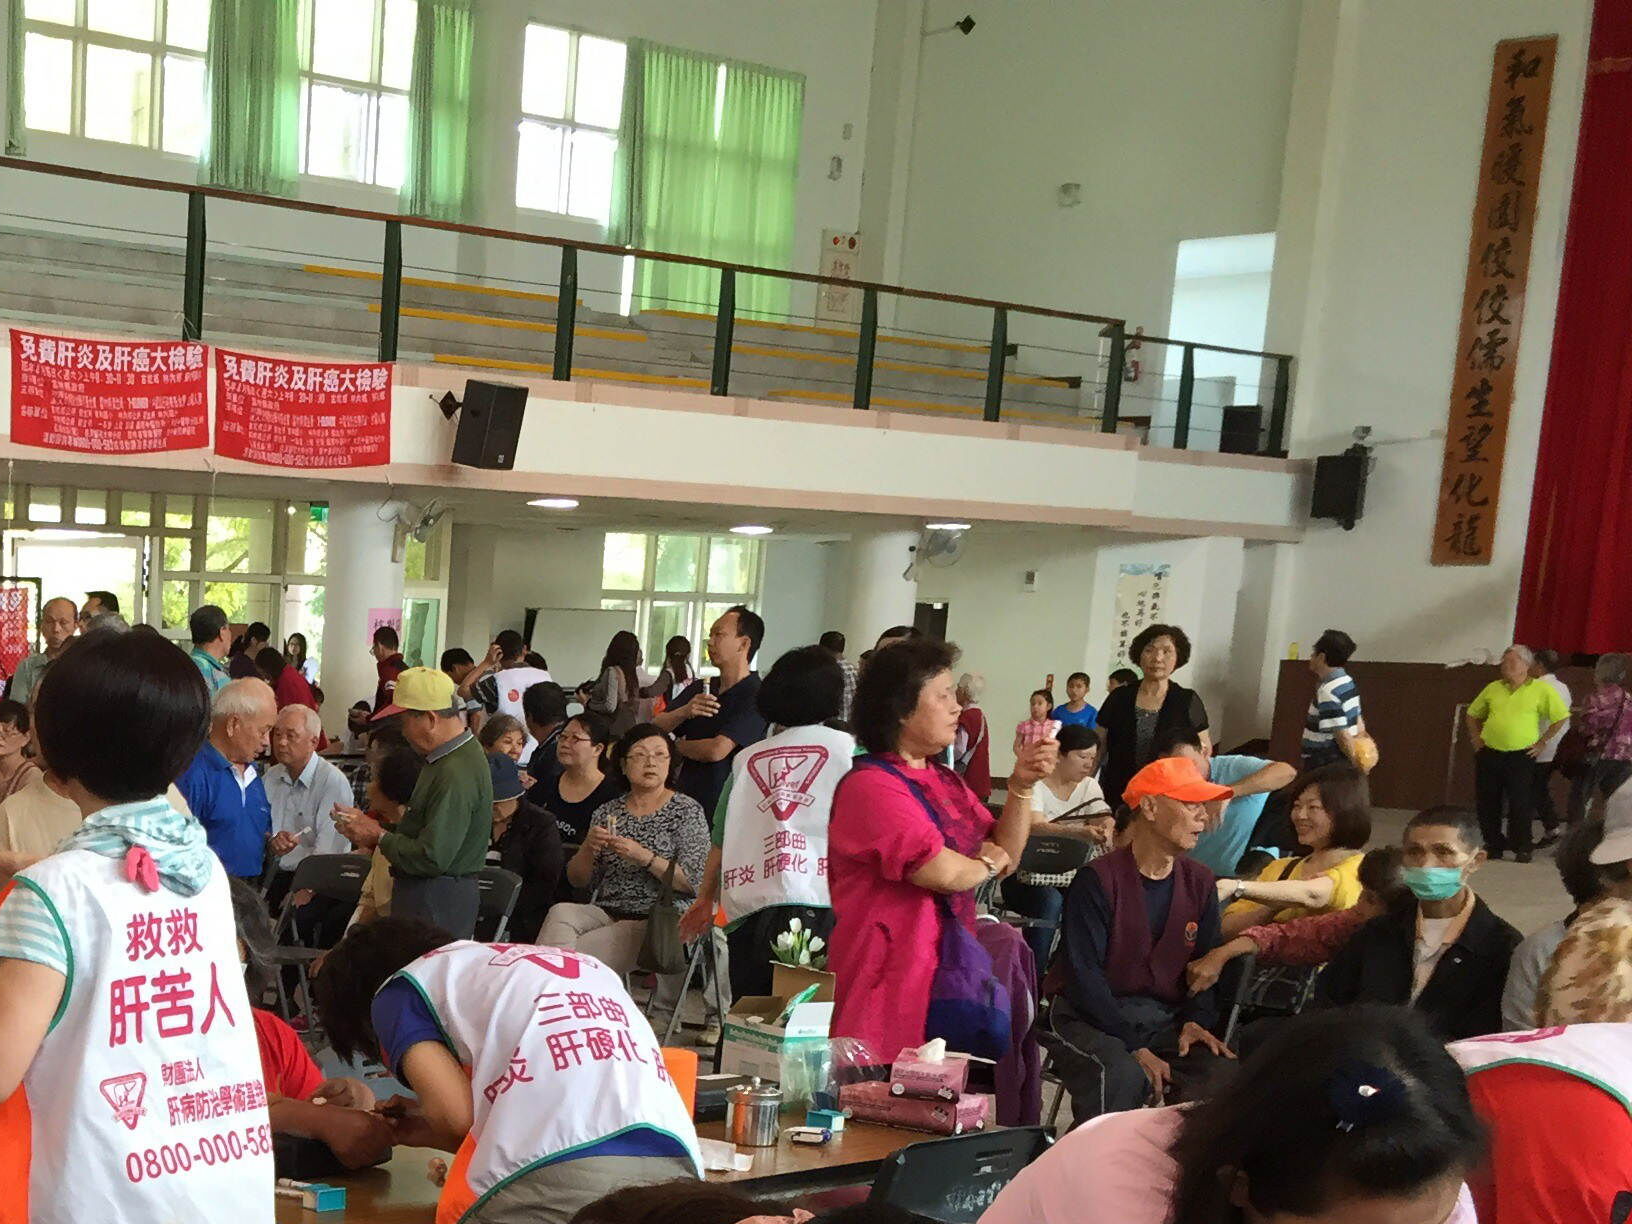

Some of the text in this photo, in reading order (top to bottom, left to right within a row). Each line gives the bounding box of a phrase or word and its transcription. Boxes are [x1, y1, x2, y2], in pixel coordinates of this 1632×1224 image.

[19, 334, 204, 372] 免費肝炎及肝癌大檢驗
[223, 354, 389, 393] 免費肝炎及肝癌大檢驗
[763, 830, 806, 855] 三部曲
[723, 865, 755, 891] 肝炎
[763, 852, 808, 880] 肝硬化
[126, 907, 203, 962] 救救
[109, 961, 235, 1048] 肝苦人
[534, 991, 630, 1028] 三部曲
[545, 1026, 648, 1072] 肝硬化
[126, 1123, 272, 1183] 0800-000-58
